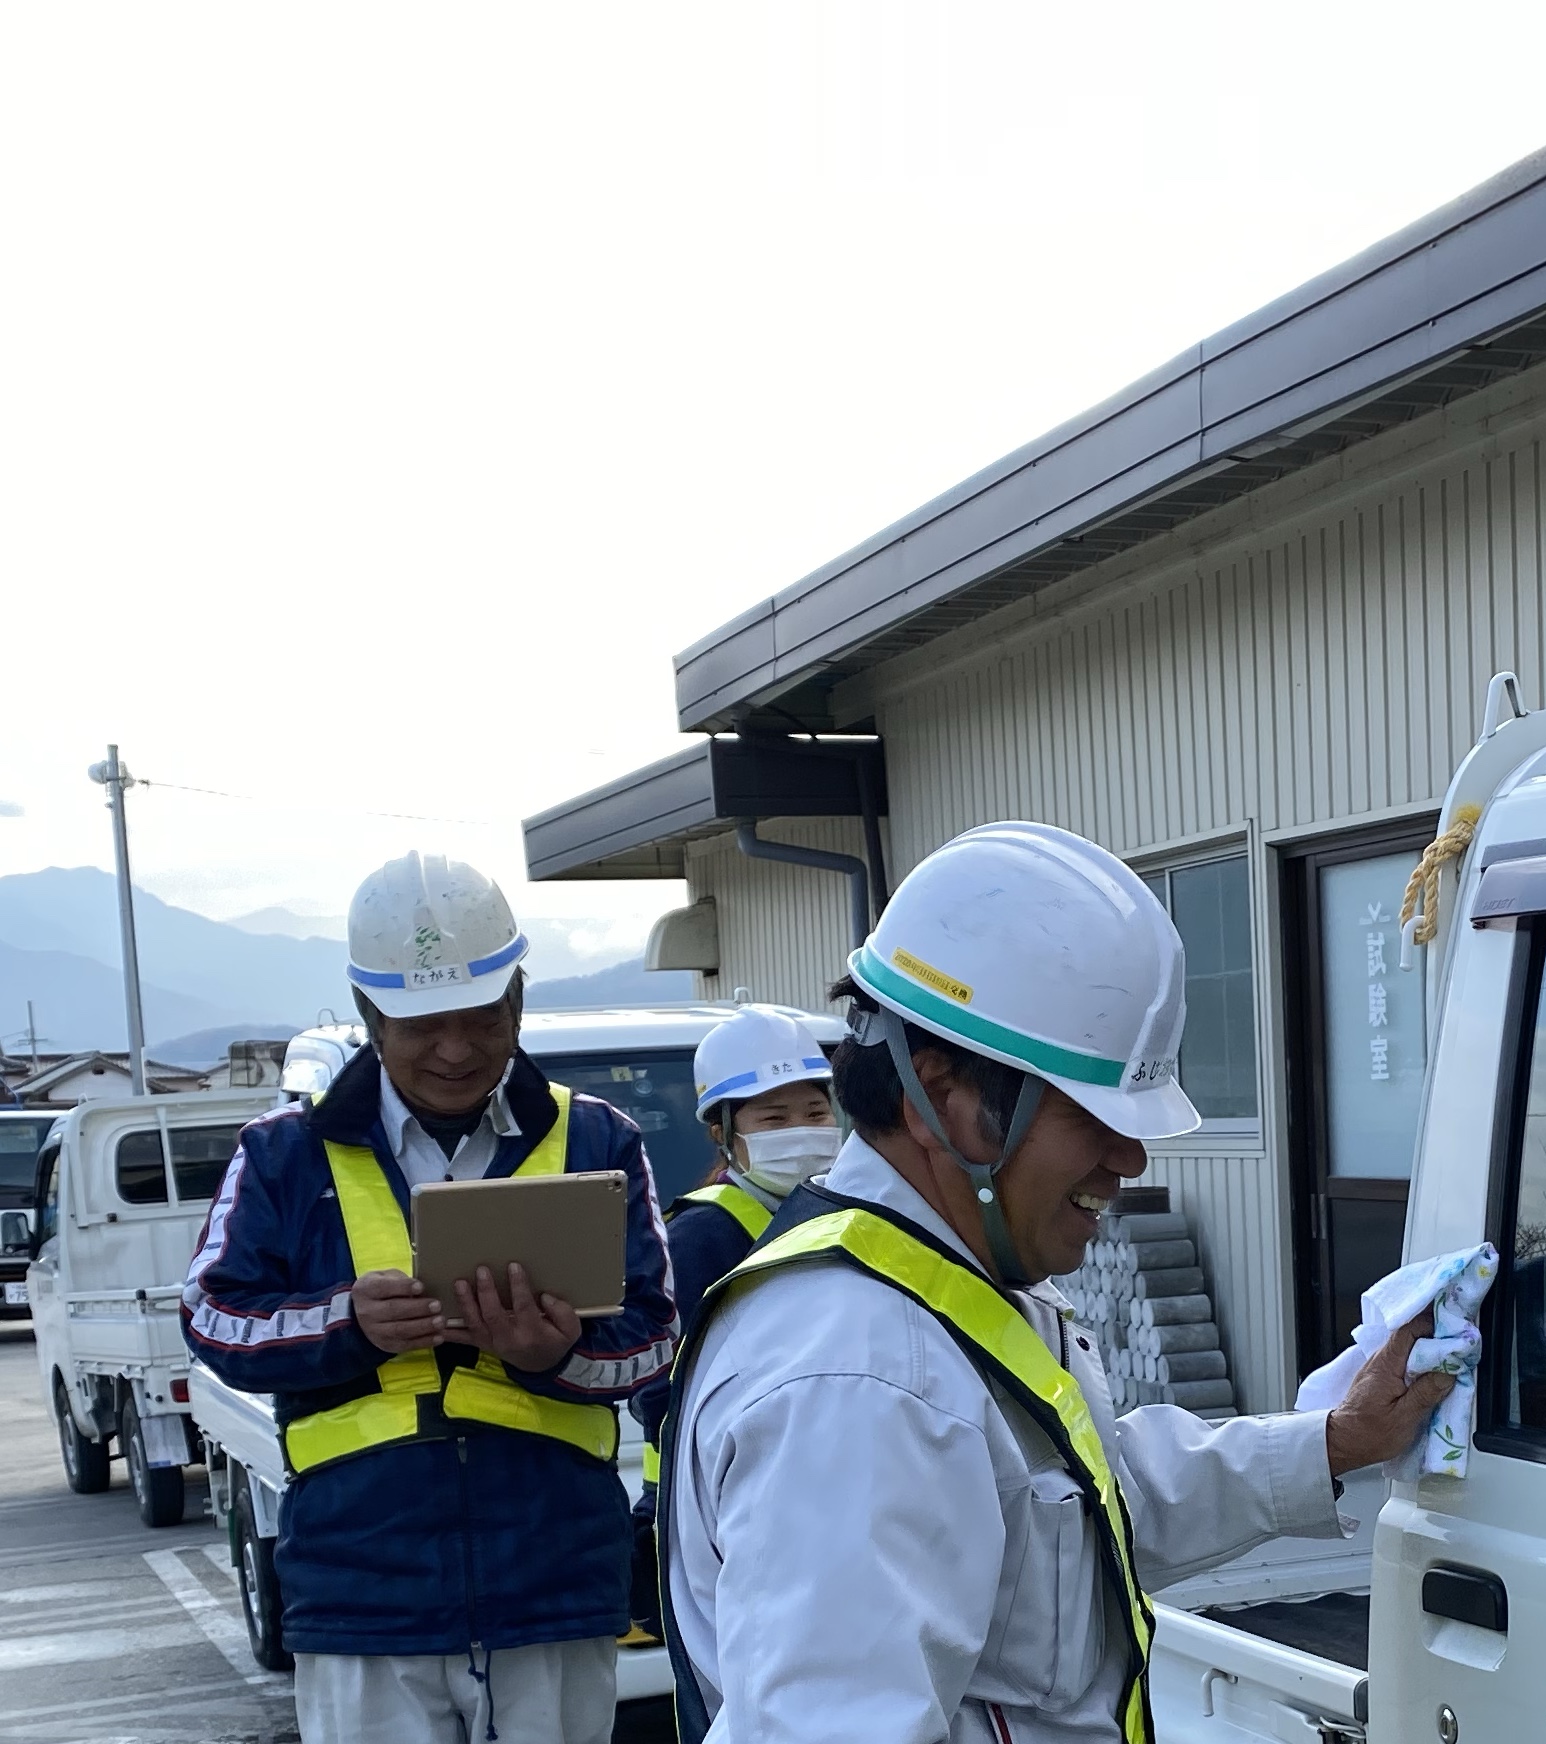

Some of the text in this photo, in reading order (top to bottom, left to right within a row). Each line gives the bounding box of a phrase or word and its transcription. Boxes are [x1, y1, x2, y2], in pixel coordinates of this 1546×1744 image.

[413, 967, 460, 985] ながえ
[771, 1061, 793, 1075] きた
